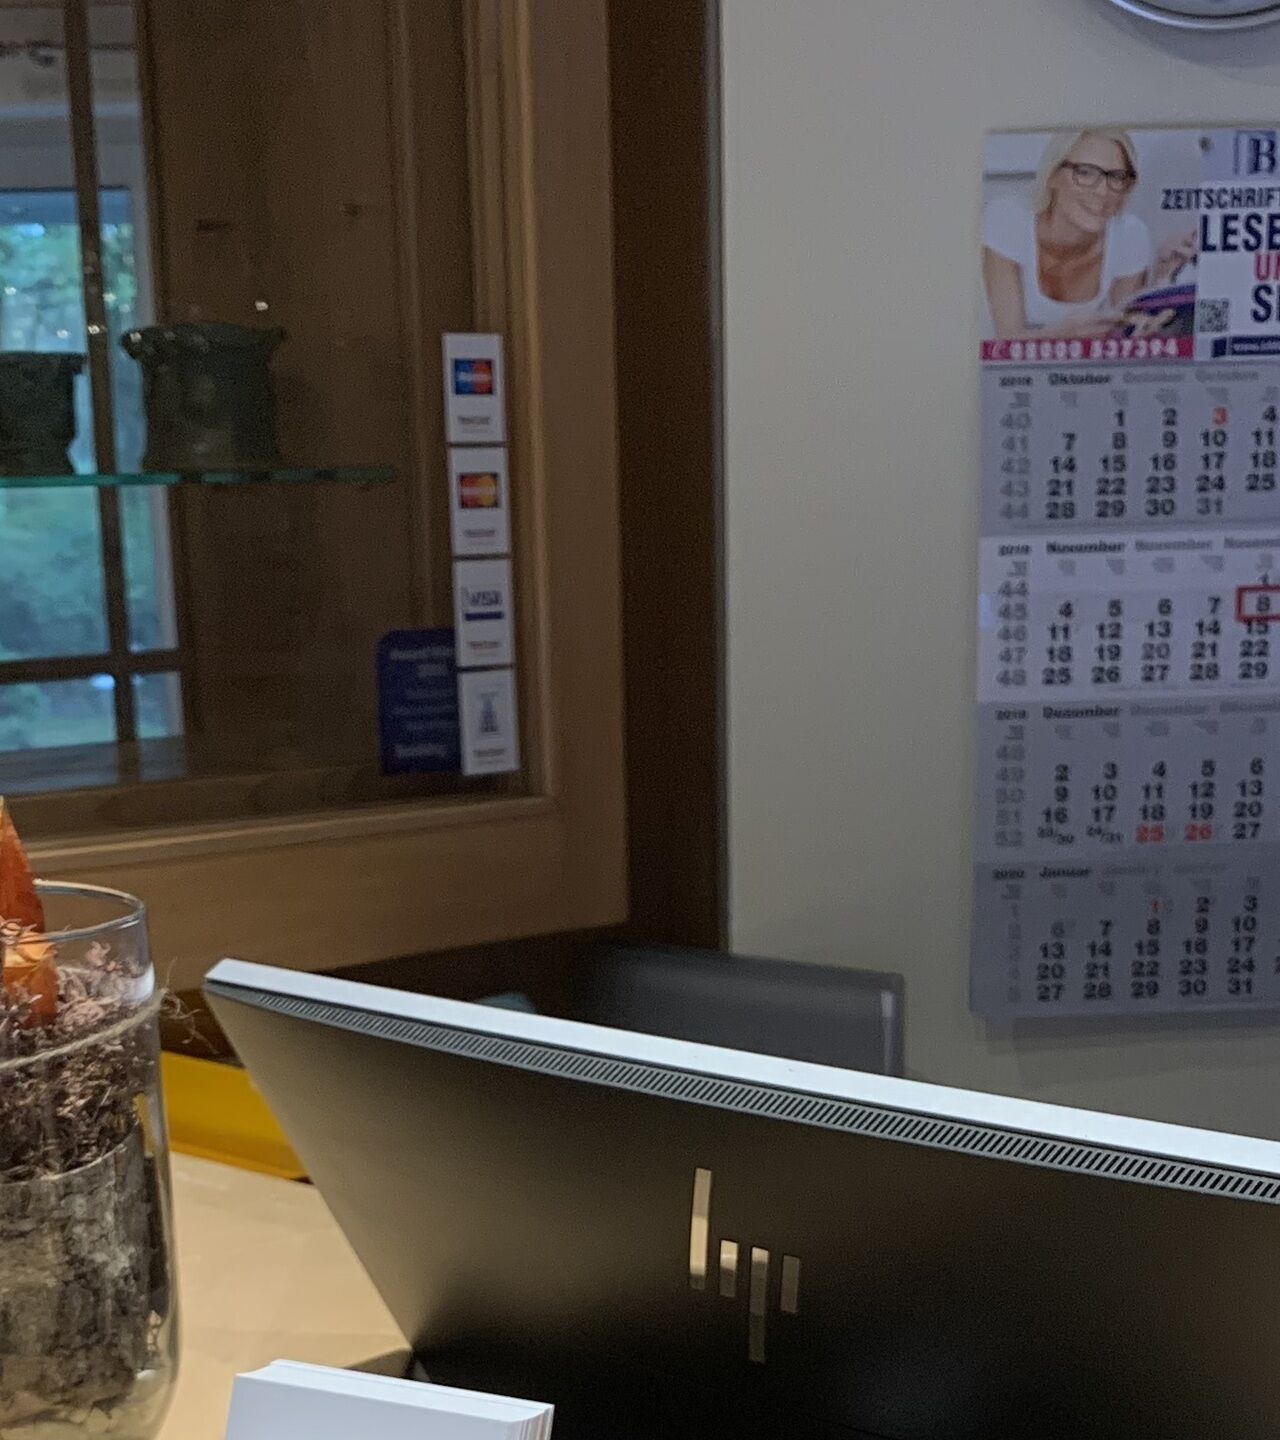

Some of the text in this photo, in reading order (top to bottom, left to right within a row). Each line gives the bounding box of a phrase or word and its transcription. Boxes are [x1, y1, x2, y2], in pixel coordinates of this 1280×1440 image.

[1048, 373, 1111, 386] Oktober
[1114, 410, 1124, 426] 1
[1164, 408, 1178, 426] 2
[1214, 406, 1228, 426] 3
[1262, 406, 1278, 422] 4
[1062, 432, 1076, 452] 7
[1112, 432, 1126, 450] 8
[1162, 430, 1178, 448] 9
[1200, 430, 1228, 448] 10
[1252, 428, 1274, 446] 11
[1052, 456, 1076, 474] 14
[1100, 454, 1126, 474] 15
[1152, 452, 1176, 472] 16
[1202, 452, 1226, 470] 17
[1250, 450, 1276, 468] 18
[1048, 478, 1074, 496] 21
[1096, 478, 1126, 496] 22
[1146, 476, 1176, 494] 23
[1196, 474, 1226, 494] 24
[1246, 472, 1276, 492] 25
[1046, 496, 1224, 520] 28 29 30 31
[1046, 541, 1126, 553] November
[1058, 602, 1074, 618] 4
[1108, 600, 1122, 618] 5
[1158, 598, 1172, 616] 6
[1208, 596, 1222, 614] 7
[1257, 595, 1270, 610] 8
[1048, 624, 1070, 640] 11
[1098, 622, 1122, 640] 12
[1146, 620, 1172, 638] 13
[1196, 620, 1220, 636] 14
[1246, 620, 1268, 636] 15
[1046, 646, 1072, 664] 18
[1096, 644, 1122, 662] 19
[1142, 642, 1170, 662] 20
[1192, 640, 1218, 660] 21
[1240, 640, 1268, 658] 22
[1042, 666, 1072, 686] 25
[1092, 666, 1120, 684] 26
[1142, 664, 1170, 682] 27
[1190, 662, 1220, 680] 28
[1238, 662, 1268, 680] 29
[1042, 706, 1120, 718] Dezember
[1056, 764, 1070, 782] 2
[1104, 762, 1118, 780] 3
[1152, 762, 1166, 778] 4
[1202, 760, 1216, 778] 5
[1250, 758, 1264, 776] 6
[1054, 786, 1068, 802] 9
[1092, 784, 1118, 802] 10
[1142, 782, 1164, 800] 11
[1188, 780, 1214, 800] 12
[1238, 780, 1264, 798] 13
[1042, 806, 1068, 824] 16
[1092, 804, 1116, 822] 17
[1140, 804, 1166, 822] 18
[1188, 802, 1214, 820] 19
[1234, 800, 1262, 818] 20
[1136, 824, 1164, 844] 25
[1184, 824, 1212, 842] 26
[1232, 822, 1260, 840] 27
[992, 868, 1025, 879] 2020
[1040, 866, 1091, 878] Januar
[1196, 896, 1210, 914] 2
[1244, 894, 1258, 912] 3
[1100, 920, 1112, 938] 7
[1146, 918, 1160, 936] 8
[1194, 918, 1208, 934] 9
[1232, 916, 1258, 934] 10
[1040, 942, 1066, 960] 13
[1088, 940, 1112, 958] 14
[1134, 938, 1160, 956] 15
[1182, 938, 1208, 956] 16
[1232, 936, 1256, 952] 17
[1036, 962, 1066, 982] 20
[1086, 962, 1110, 980] 21
[1132, 960, 1160, 978] 22
[1178, 958, 1208, 976] 23
[1228, 956, 1256, 974] 24
[1038, 976, 1252, 1002] 27 28 29 30 31
